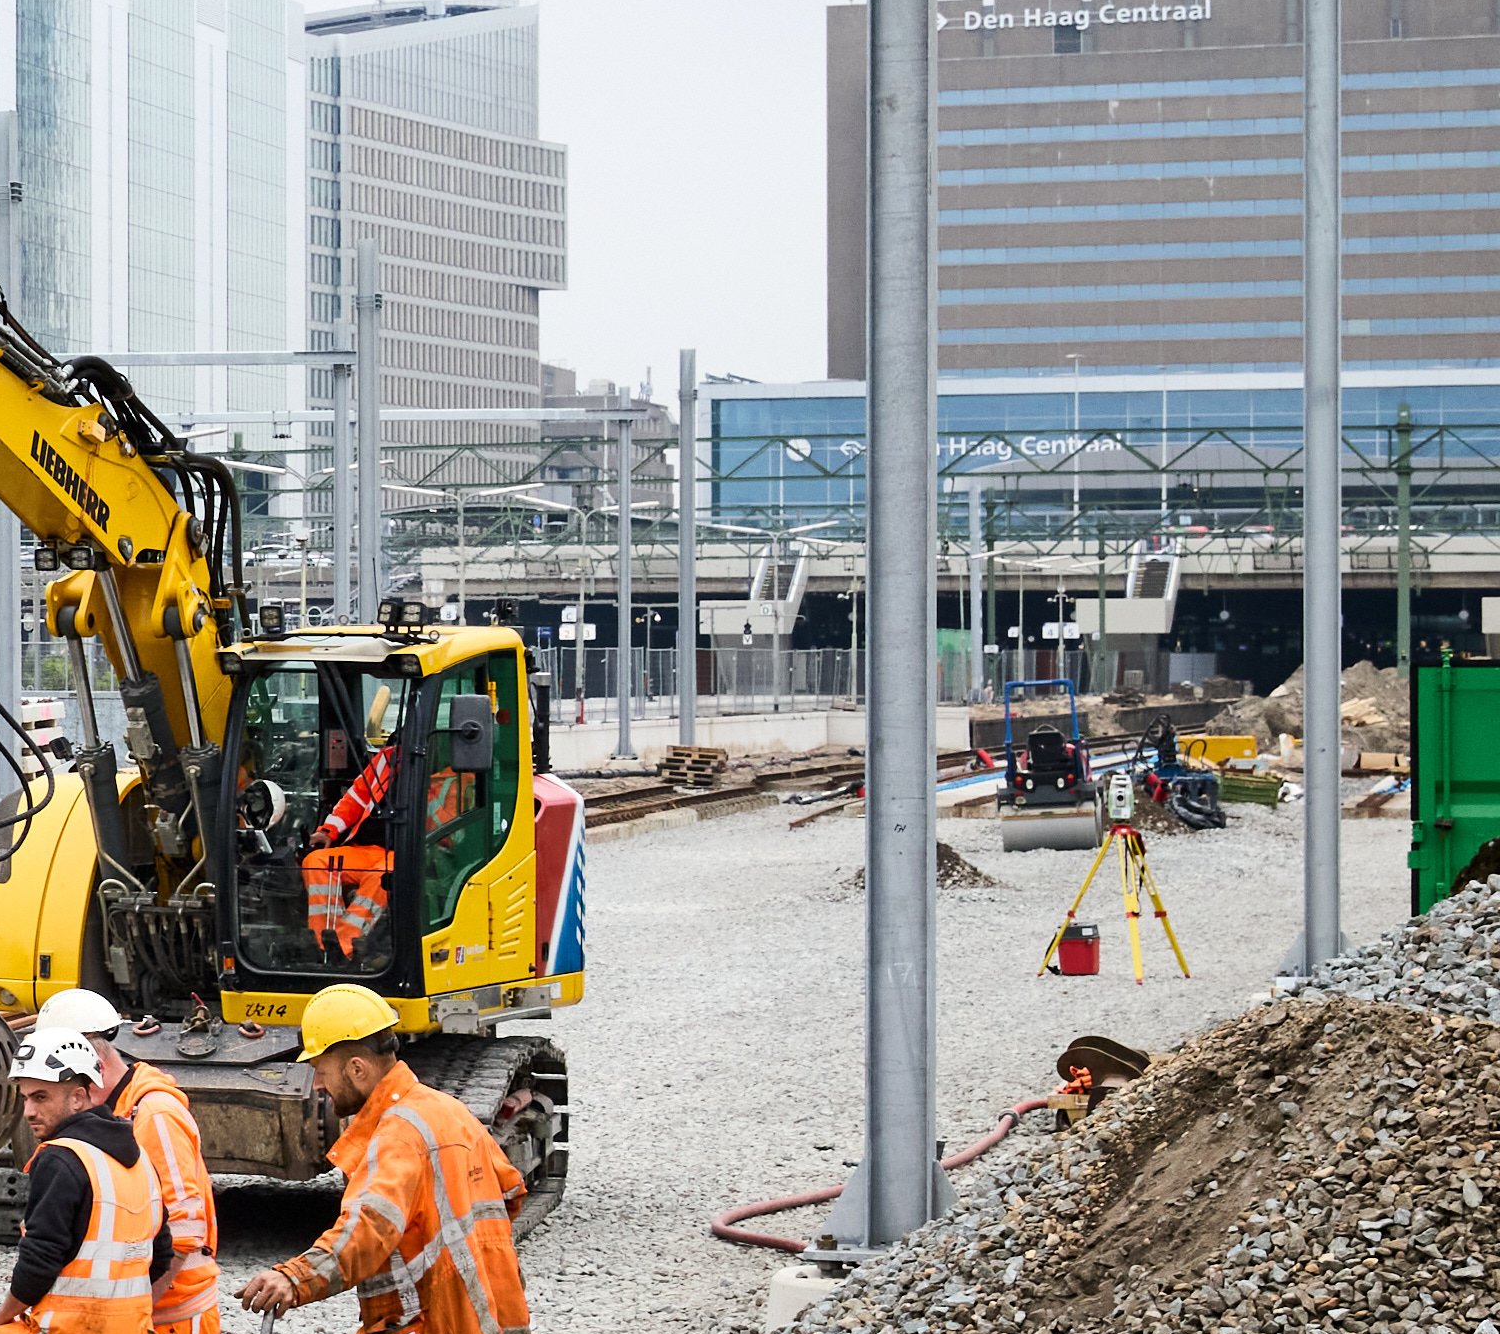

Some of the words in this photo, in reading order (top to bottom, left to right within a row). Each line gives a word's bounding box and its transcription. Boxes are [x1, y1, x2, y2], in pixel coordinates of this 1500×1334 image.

[964, 10, 1014, 30] Den
[1024, 7, 1090, 30] Haag
[950, 437, 1012, 460] Haag
[1021, 433, 1122, 455] Centraal
[31, 430, 110, 534] LIEBHERR
